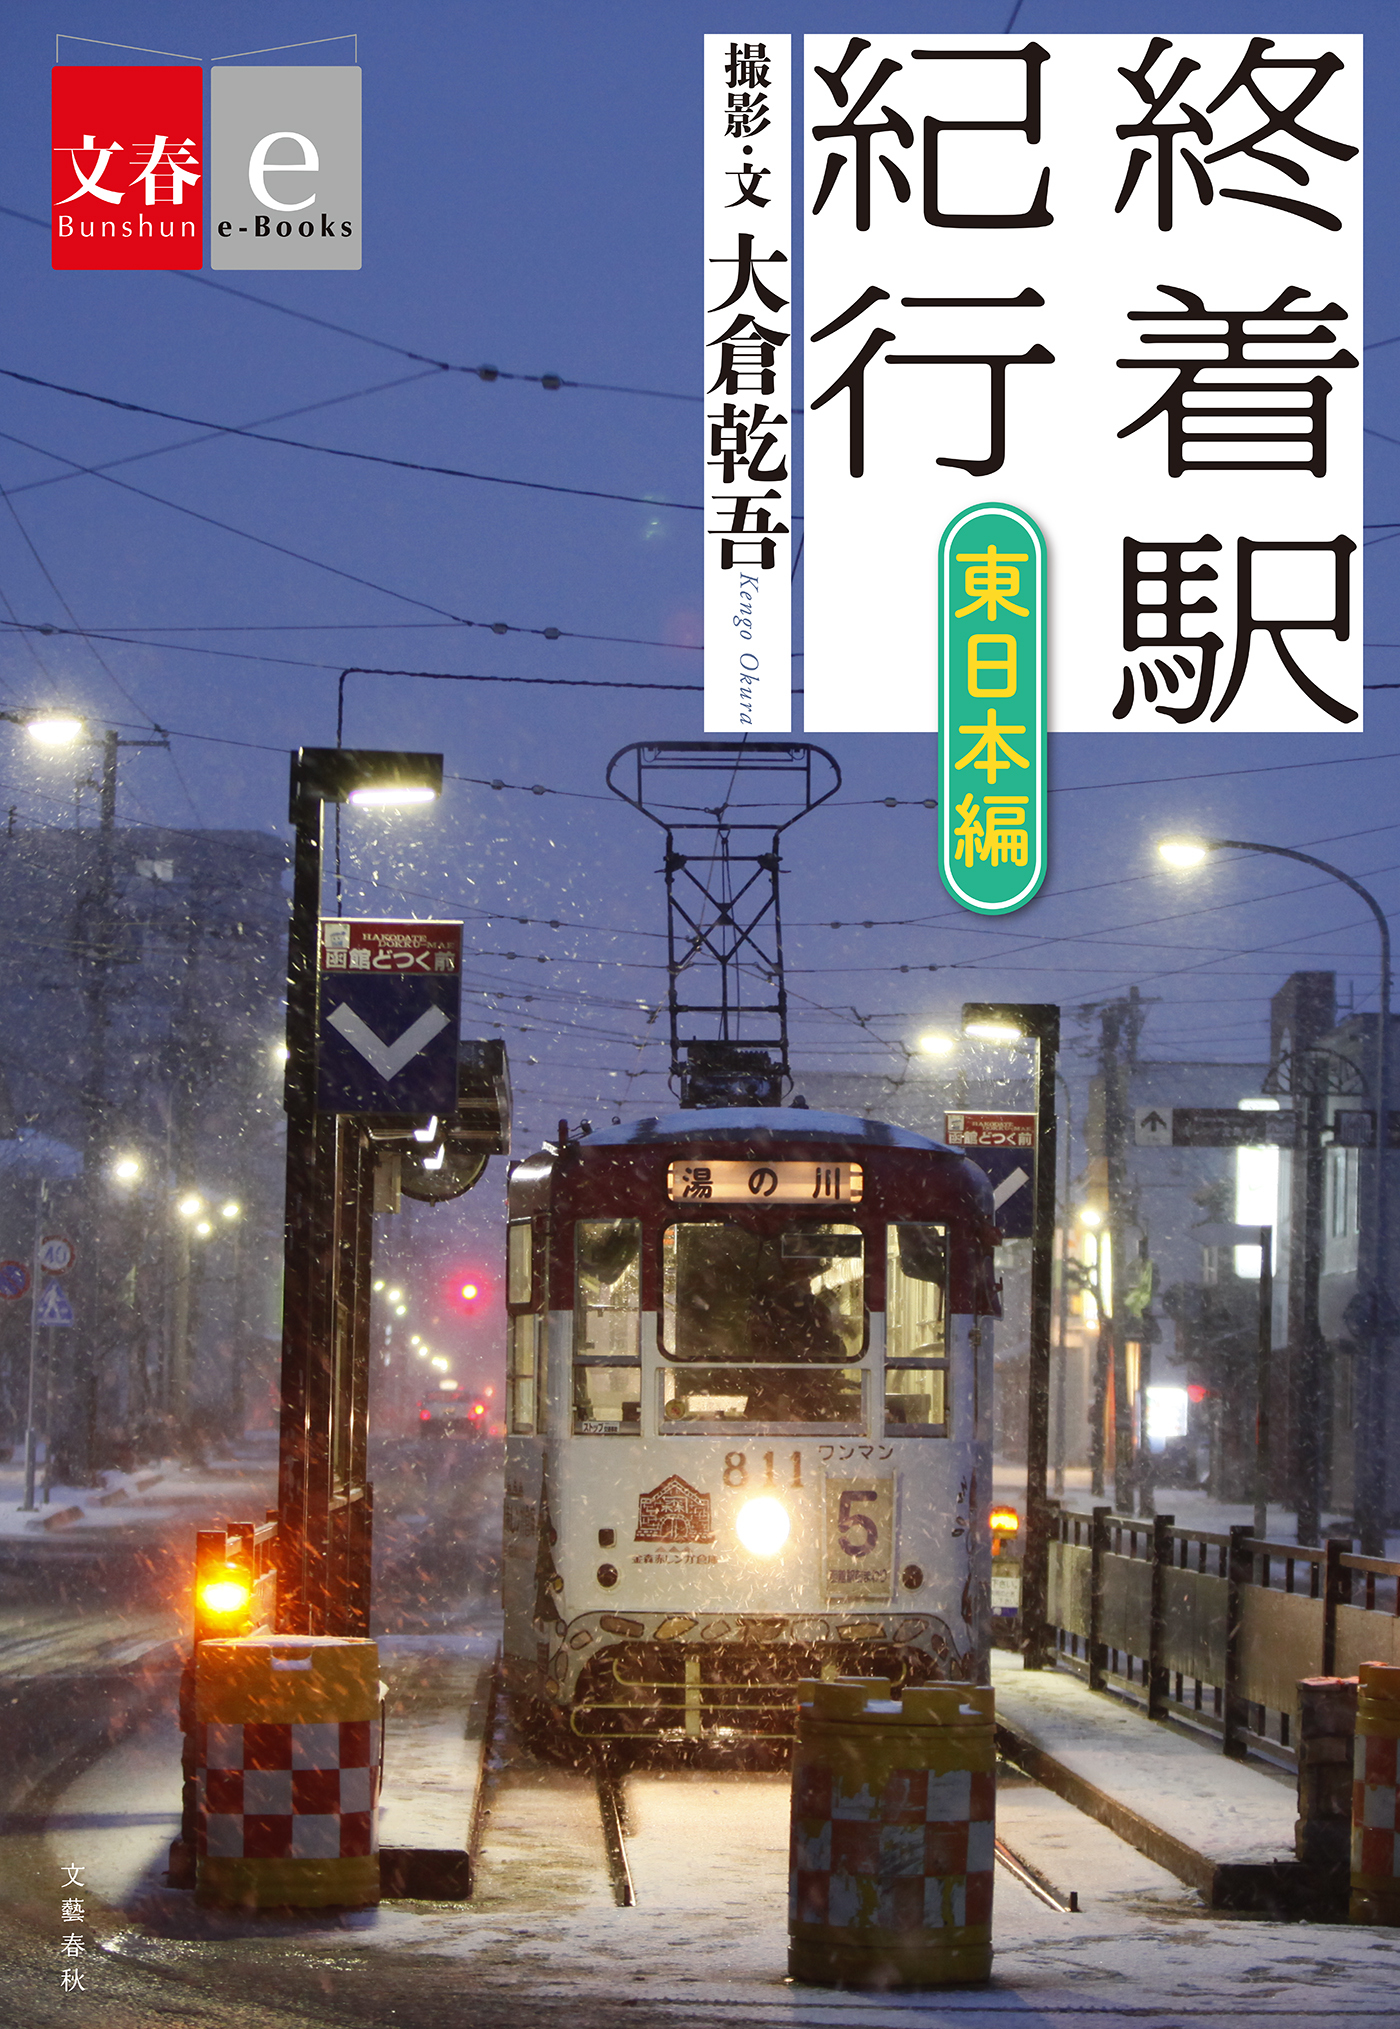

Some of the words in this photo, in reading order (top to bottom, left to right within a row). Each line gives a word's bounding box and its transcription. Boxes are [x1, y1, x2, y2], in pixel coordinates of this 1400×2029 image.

[362, 932, 427, 942] HAKODATE
[378, 940, 455, 949] DOKKU-MAE
[324, 947, 456, 972] 函館どつく前
[948, 1131, 1032, 1146] 函館どつく前
[682, 1167, 841, 1200] 湯の川
[44, 1246, 68, 1264] 40
[818, 1445, 894, 1461] ワンマン
[723, 1451, 804, 1489] 811
[838, 1491, 879, 1558] 5
